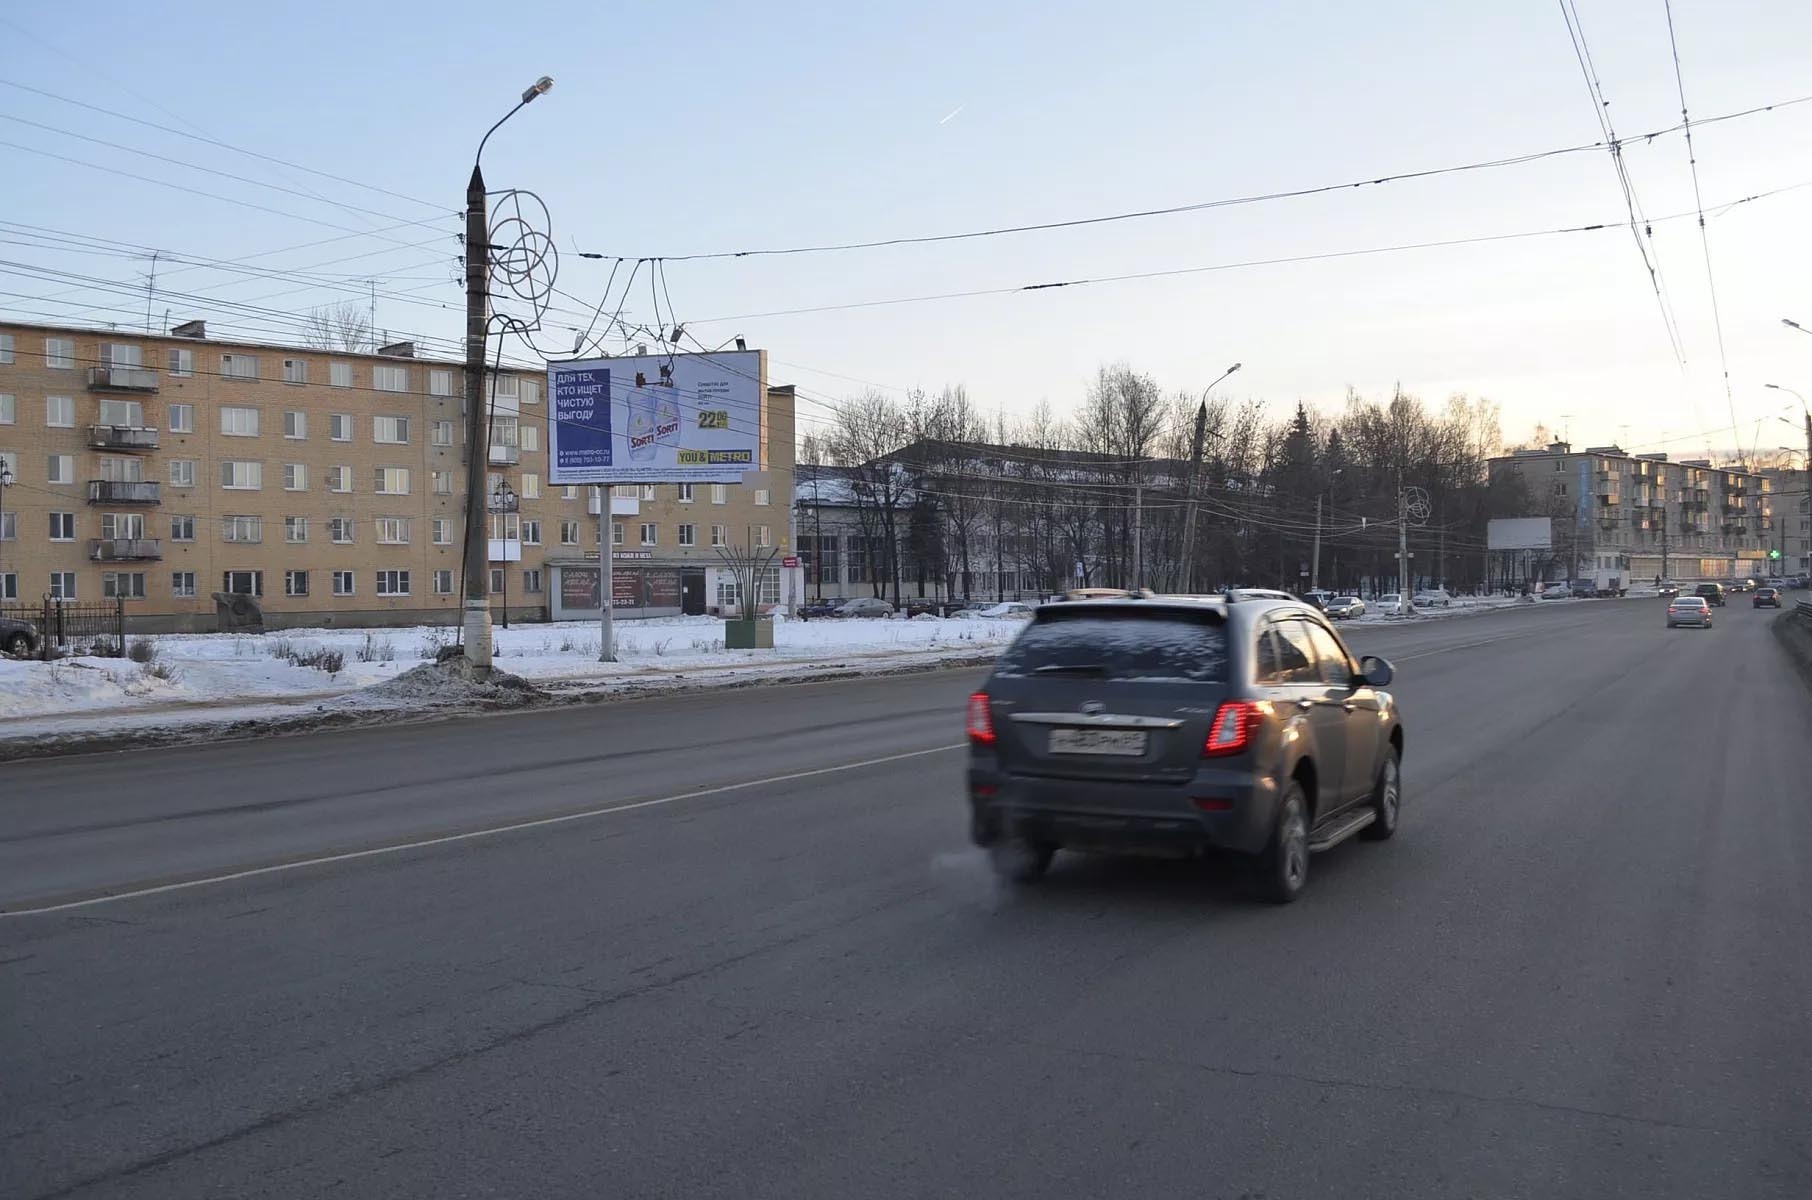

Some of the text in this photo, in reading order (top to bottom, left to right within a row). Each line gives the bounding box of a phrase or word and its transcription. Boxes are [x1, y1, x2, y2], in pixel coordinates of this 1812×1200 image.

[557, 373, 595, 384] ДЛЯ ТЕХ,
[557, 384, 603, 395] КТО ИЩЕТ
[557, 397, 594, 408] ЧИСТУЮ
[557, 410, 594, 421] ВЫГОДУ
[698, 412, 716, 428] 22
[656, 422, 678, 437] SORTI
[631, 434, 655, 449] SORTI
[679, 451, 750, 463] YOU & METRO
